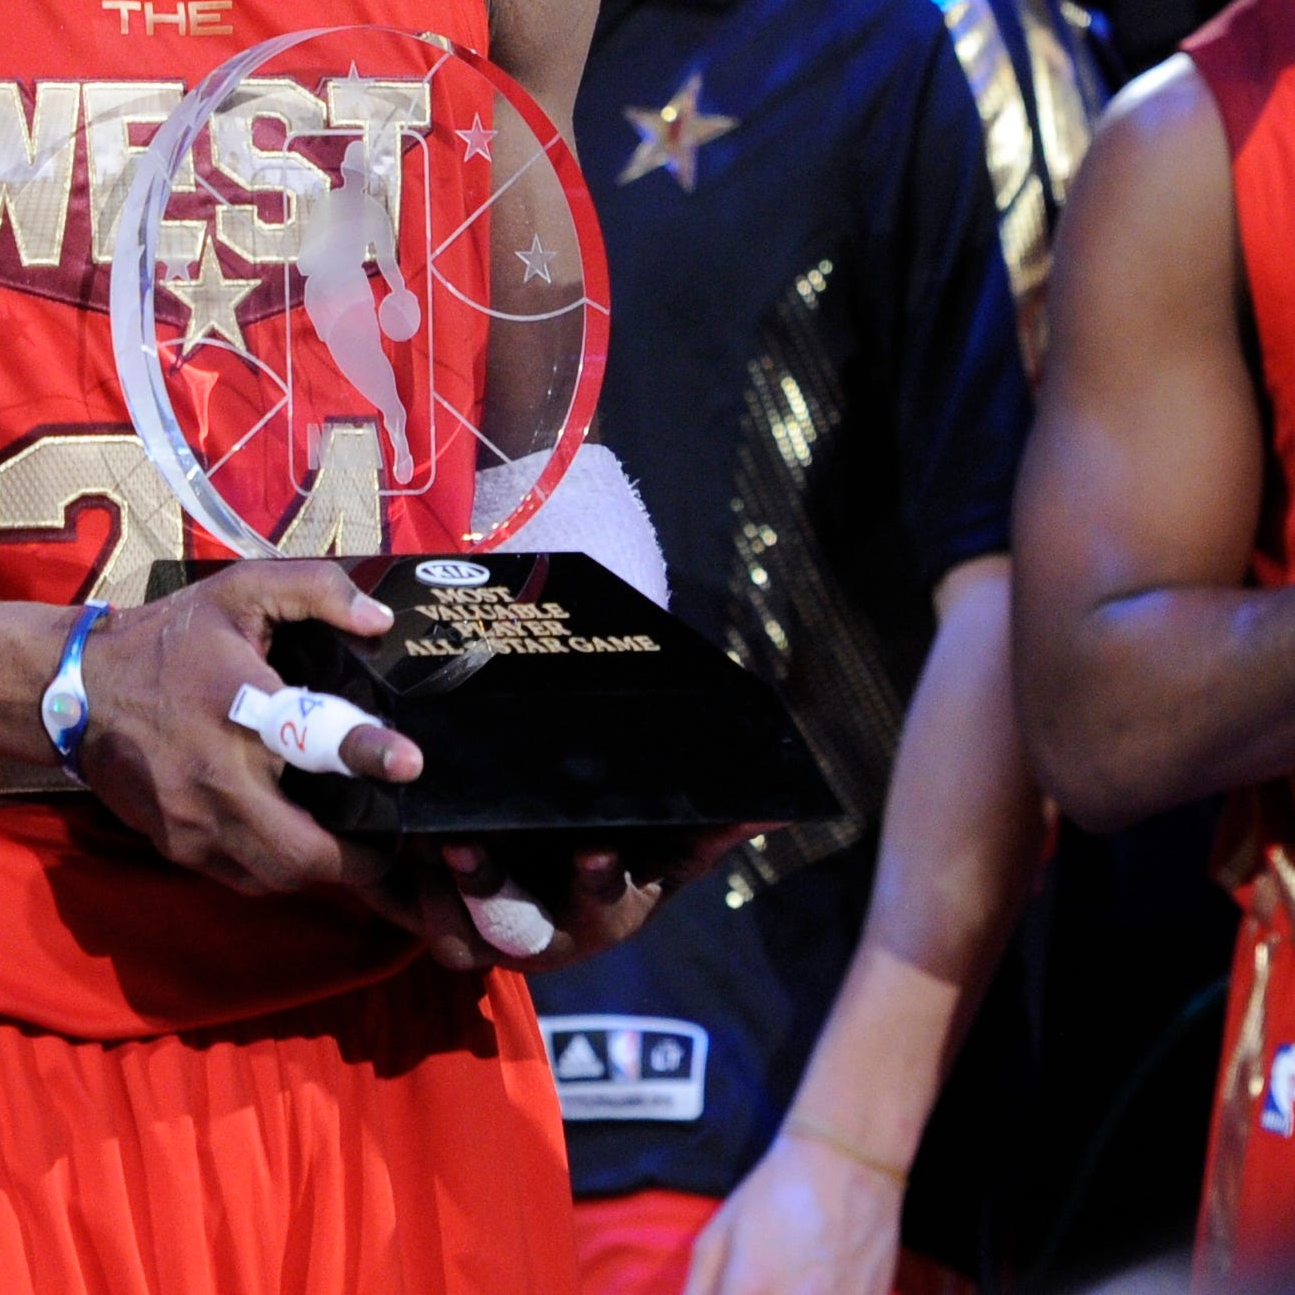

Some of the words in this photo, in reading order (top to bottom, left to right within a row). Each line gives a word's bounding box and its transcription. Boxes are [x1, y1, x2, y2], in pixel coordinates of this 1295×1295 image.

[420, 562, 486, 582] KIA
[430, 587, 516, 604] MOST
[414, 603, 571, 622] VALUABLE
[451, 619, 572, 639] PLAYER
[568, 634, 661, 654] GAME
